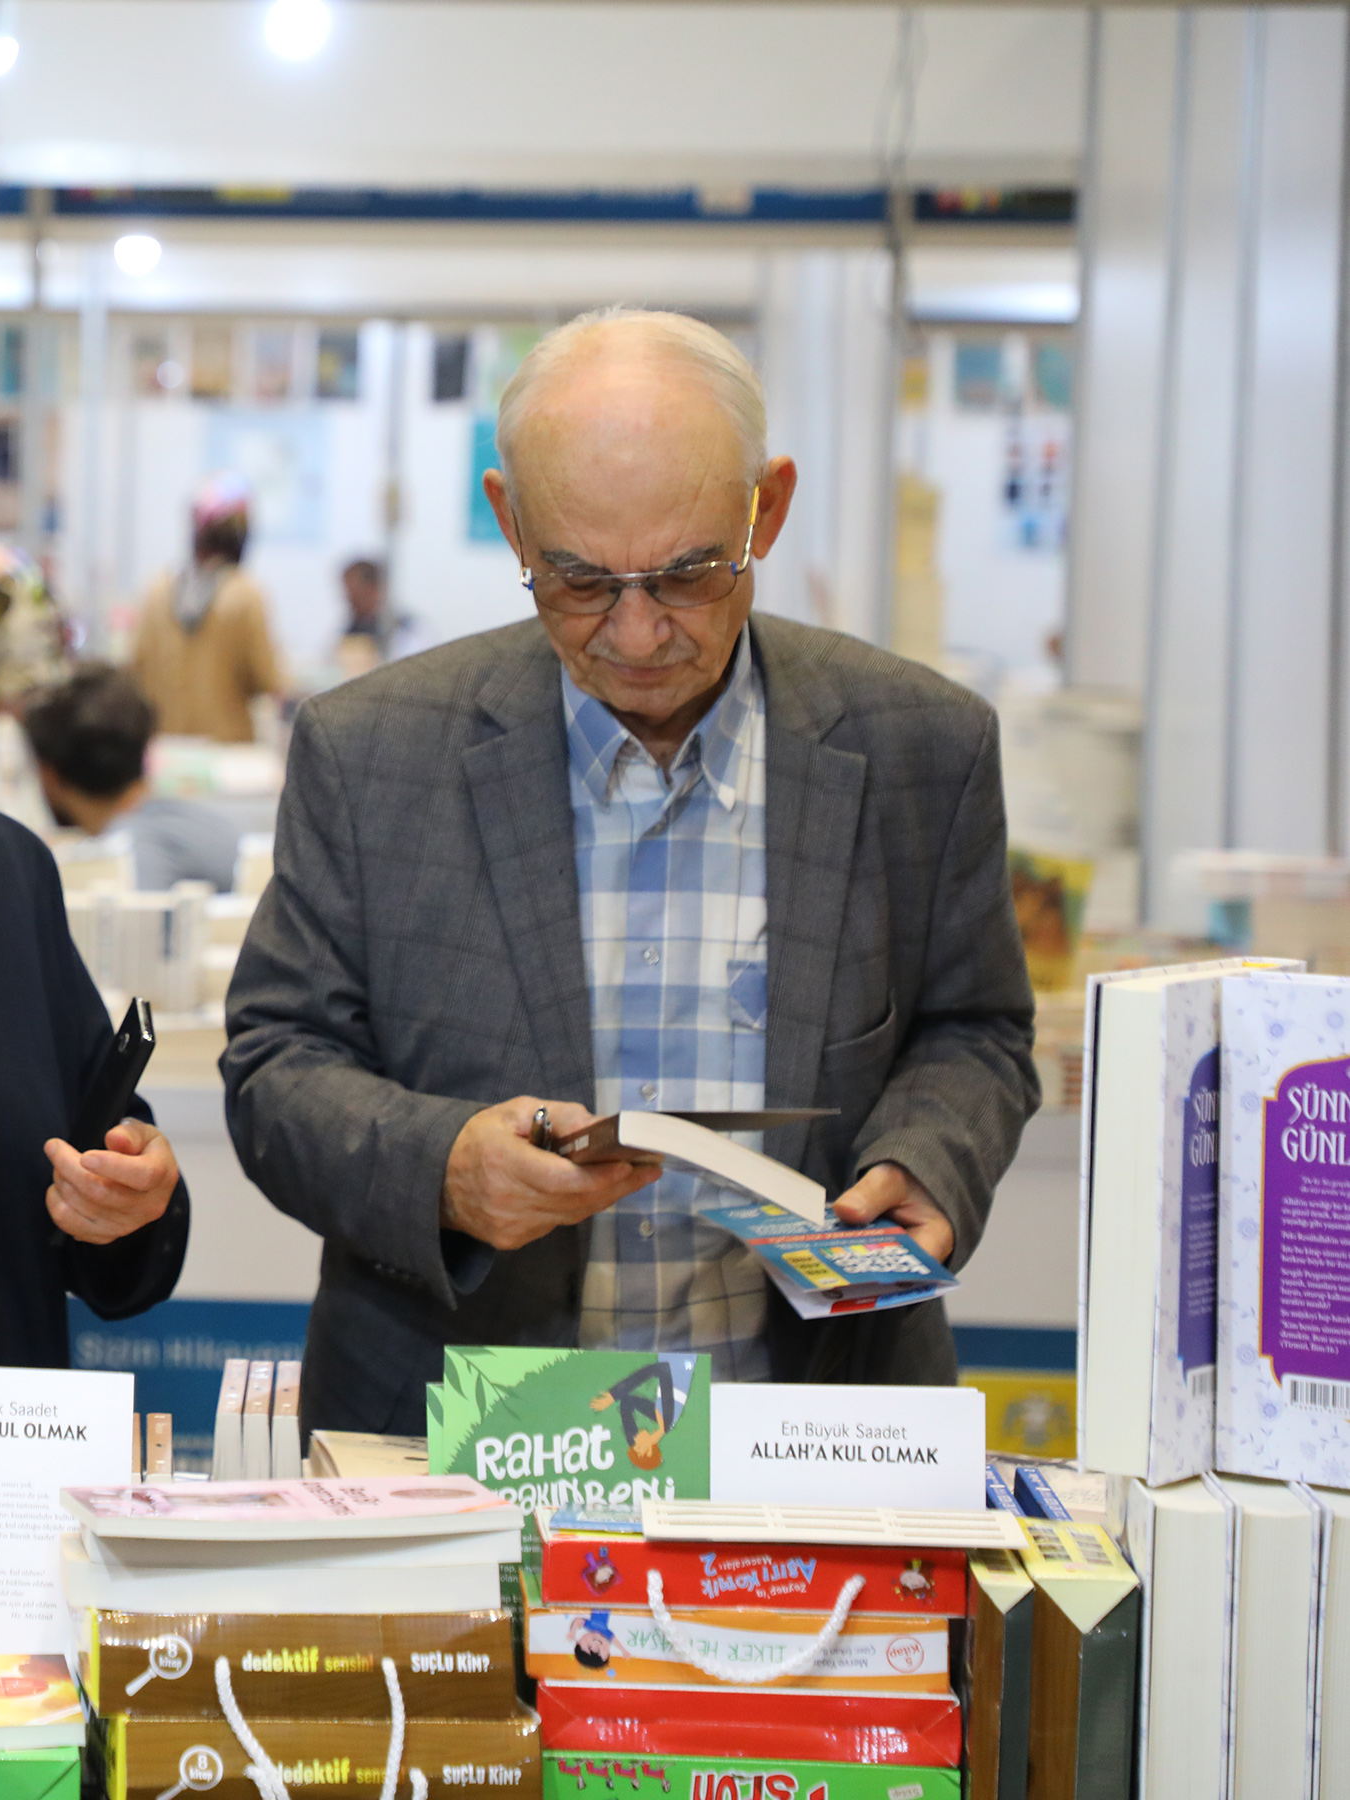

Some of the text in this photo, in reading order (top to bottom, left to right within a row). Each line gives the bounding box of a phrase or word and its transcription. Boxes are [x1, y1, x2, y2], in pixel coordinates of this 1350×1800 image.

[9, 1401, 59, 1419] Saadet
[25, 1423, 88, 1442] OLMAK
[781, 1420, 908, 1443] En Büyük Saadet
[750, 1441, 939, 1465] ALLAH'A KUL OLMAK
[700, 1552, 772, 1576] Maceraları 2
[756, 1582, 807, 1599] Zeynep'in
[168, 1642, 178, 1658] 8
[889, 1643, 920, 1658] Kitap
[159, 1656, 183, 1671] kitap
[242, 1646, 319, 1673] dedektif
[325, 1654, 375, 1673] sensin!
[411, 1652, 454, 1676] SUÇLU
[838, 1659, 868, 1668] Merve
[197, 1754, 208, 1770] 8
[189, 1767, 213, 1782] kitap
[443, 1764, 485, 1788] SUÇLU
